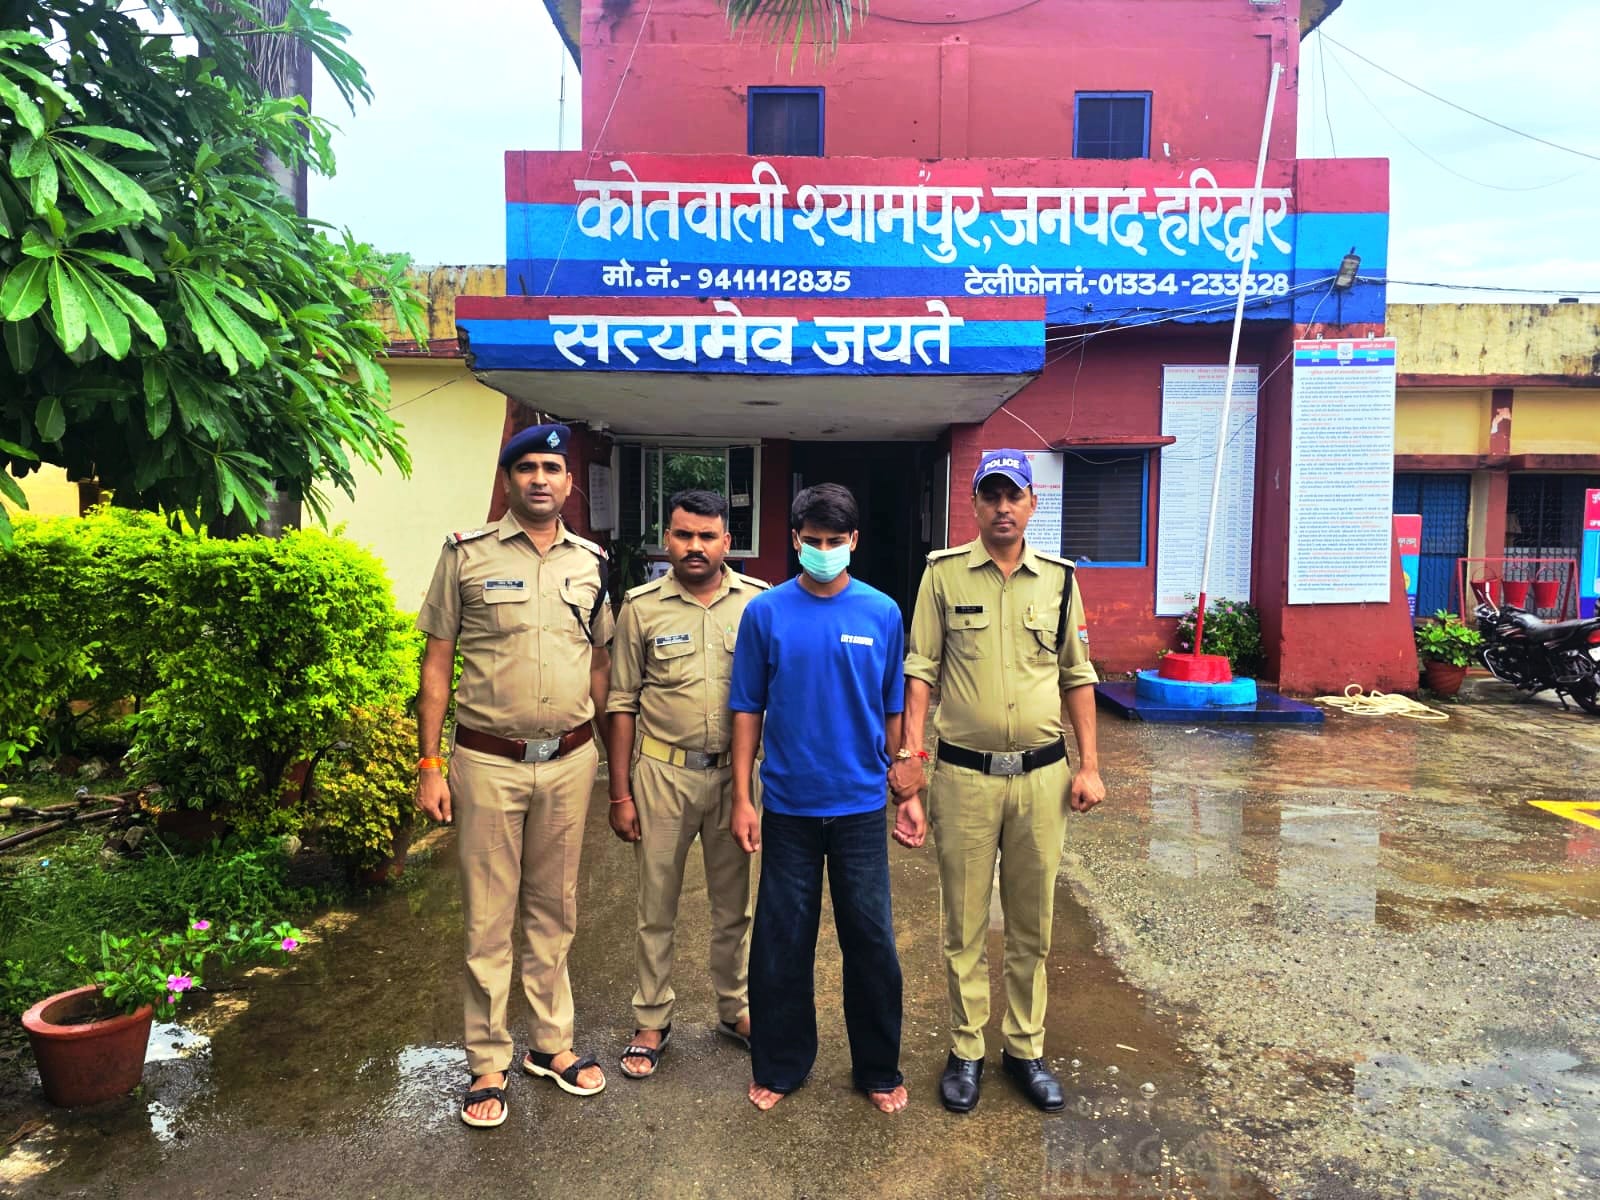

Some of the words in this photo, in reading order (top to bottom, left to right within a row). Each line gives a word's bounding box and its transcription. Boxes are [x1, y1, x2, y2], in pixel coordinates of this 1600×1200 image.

[575, 161, 788, 243] कोतवाली
[698, 268, 851, 292] 9411112835
[548, 300, 798, 366] सत्यमेव
[812, 300, 964, 367] जयते
[984, 458, 1020, 471] POLICE
